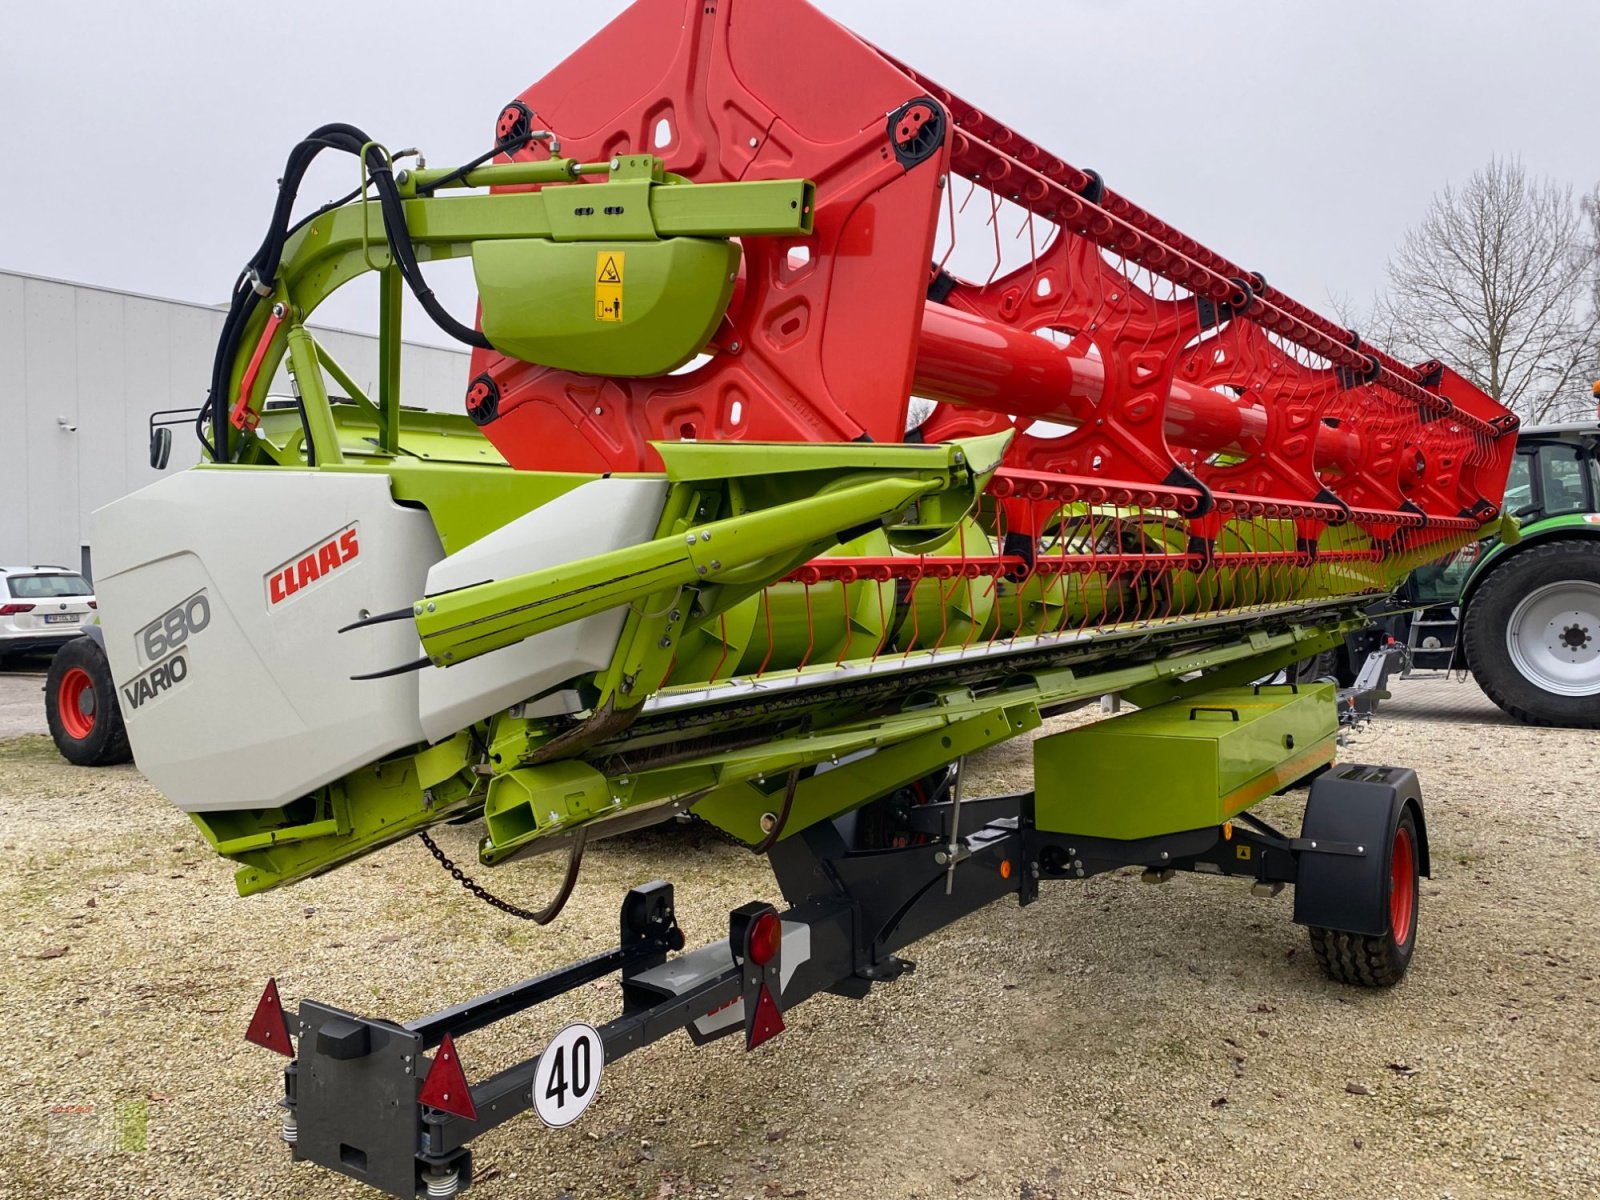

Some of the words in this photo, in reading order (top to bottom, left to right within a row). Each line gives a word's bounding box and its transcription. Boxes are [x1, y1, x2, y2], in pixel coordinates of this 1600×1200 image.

[269, 527, 359, 605] CLAAS
[143, 594, 211, 661] 680
[124, 655, 188, 710] VARIO
[545, 1035, 591, 1109] 40
